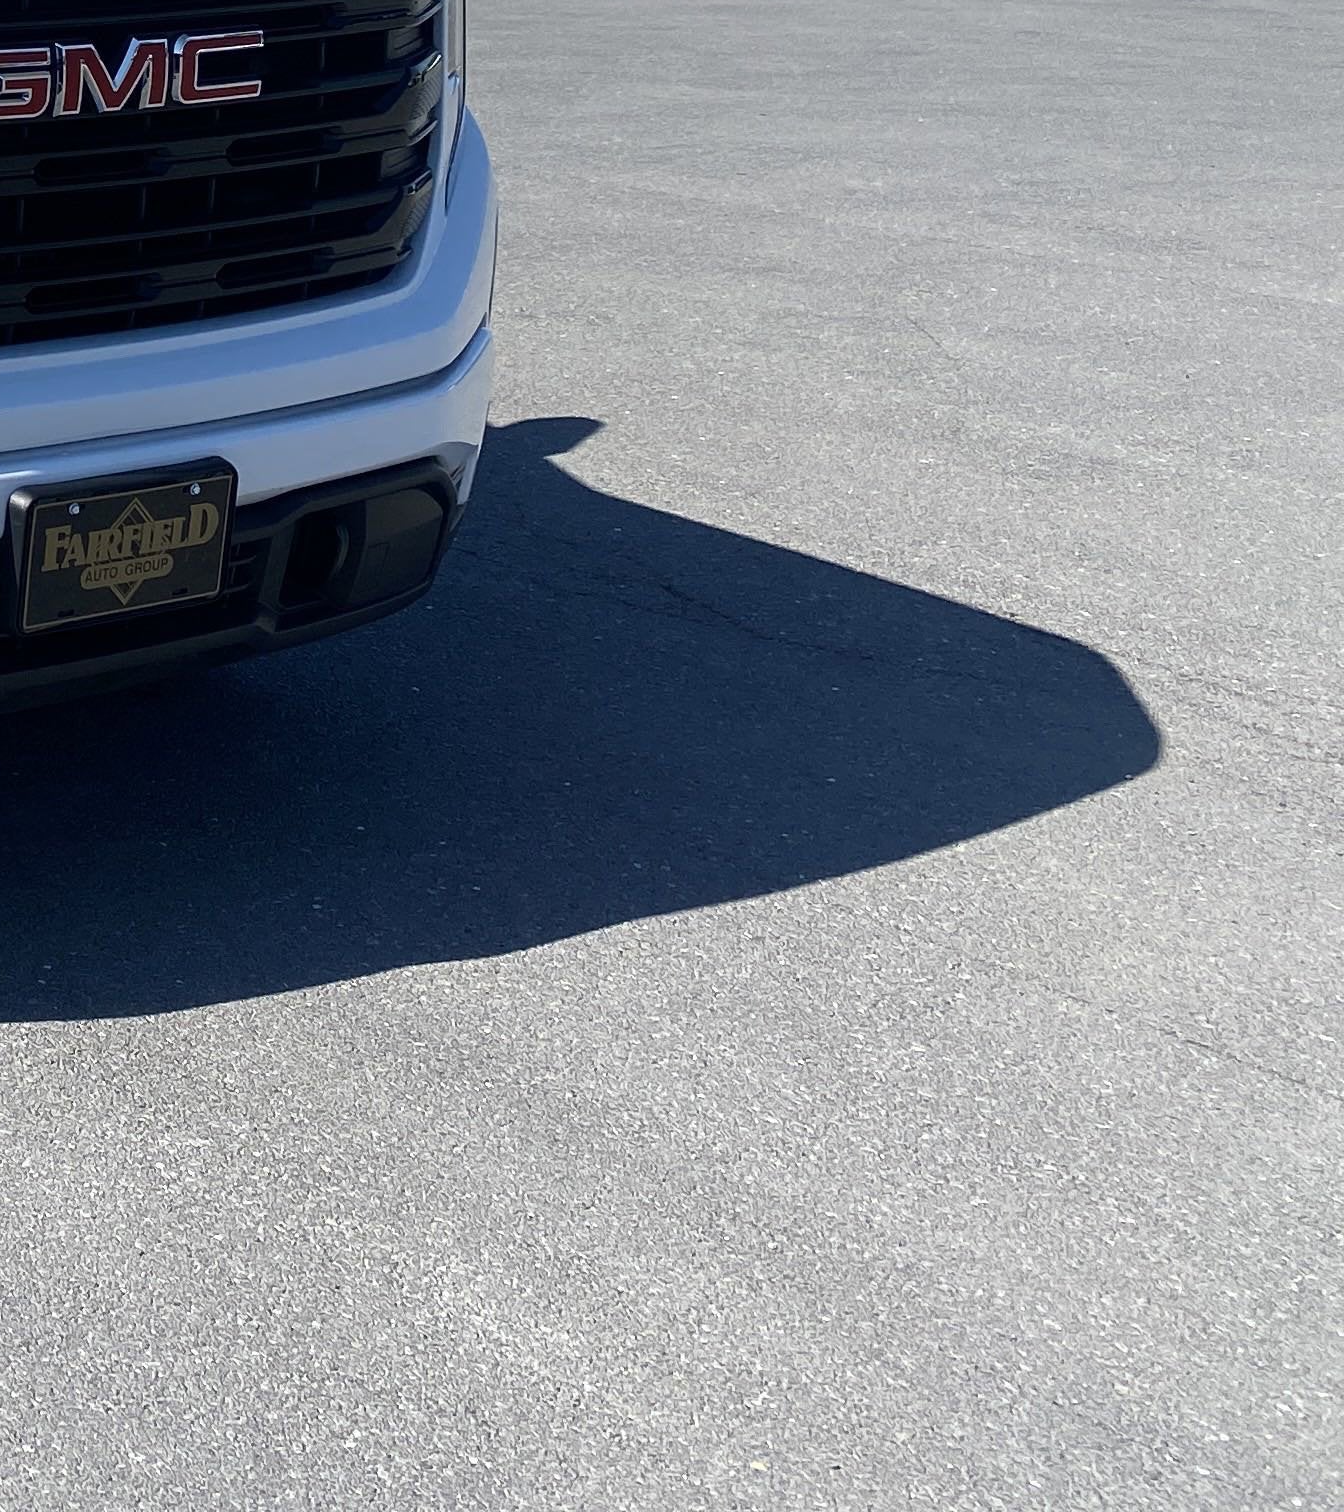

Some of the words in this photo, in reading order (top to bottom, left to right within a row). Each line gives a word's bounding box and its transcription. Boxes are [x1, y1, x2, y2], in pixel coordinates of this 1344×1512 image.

[41, 503, 219, 572] FAIRFIELD
[84, 567, 118, 584] AUTO
[124, 557, 169, 576] GROUP
